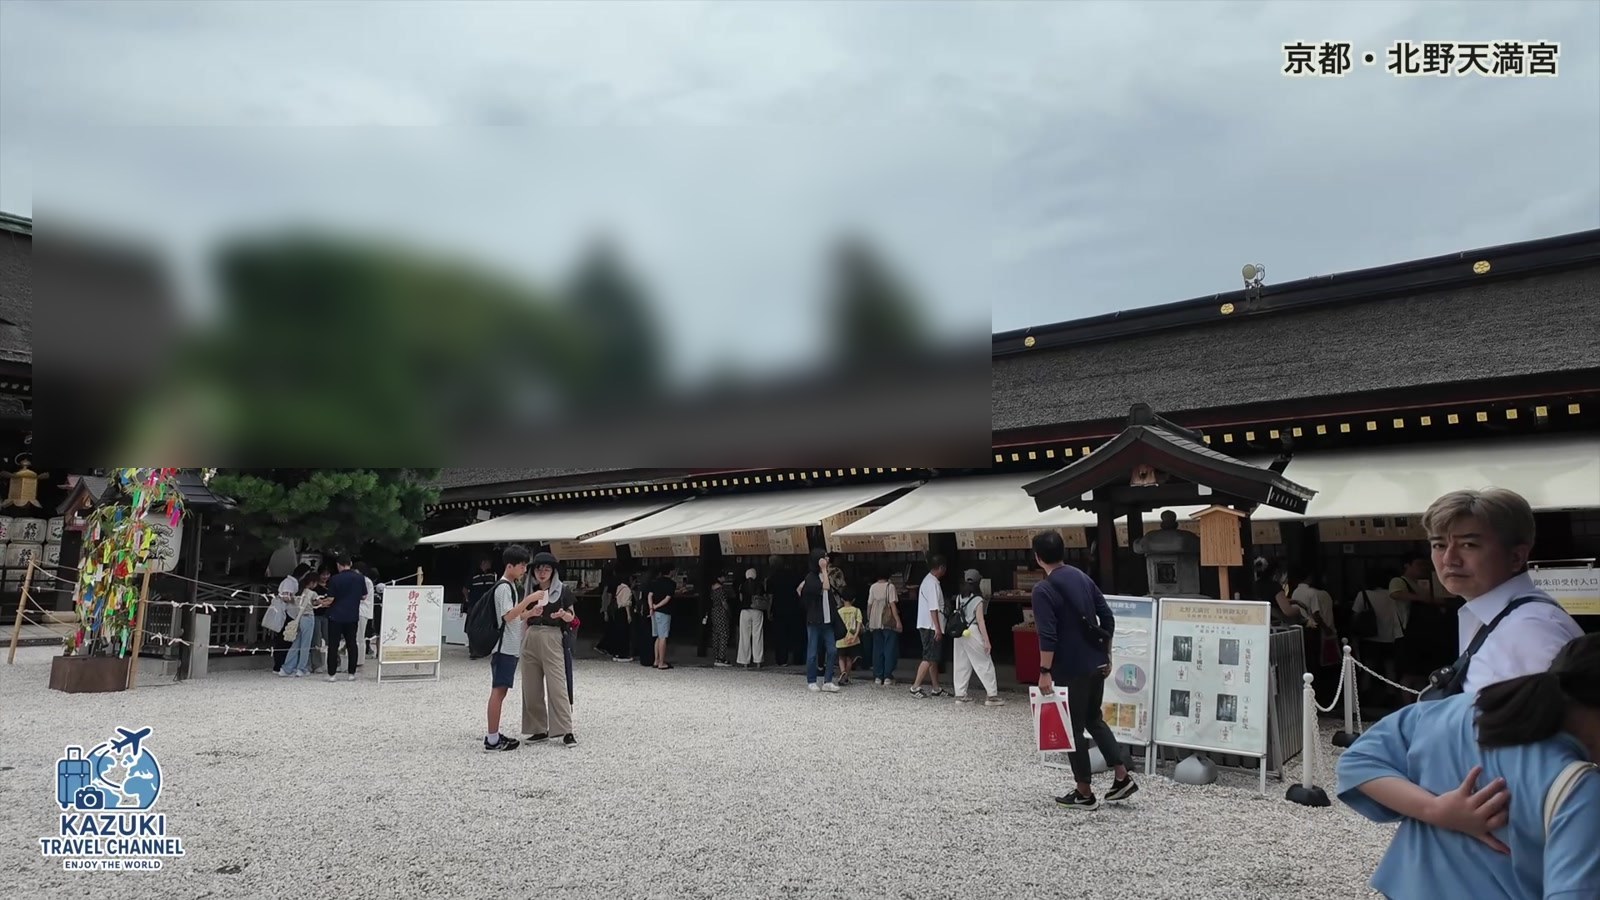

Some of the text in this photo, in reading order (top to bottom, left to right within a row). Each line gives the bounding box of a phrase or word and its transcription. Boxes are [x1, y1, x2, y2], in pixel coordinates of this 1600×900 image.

[1533, 578, 1598, 586] 御朱印受付入口
[404, 589, 420, 645] 御祈祷受付
